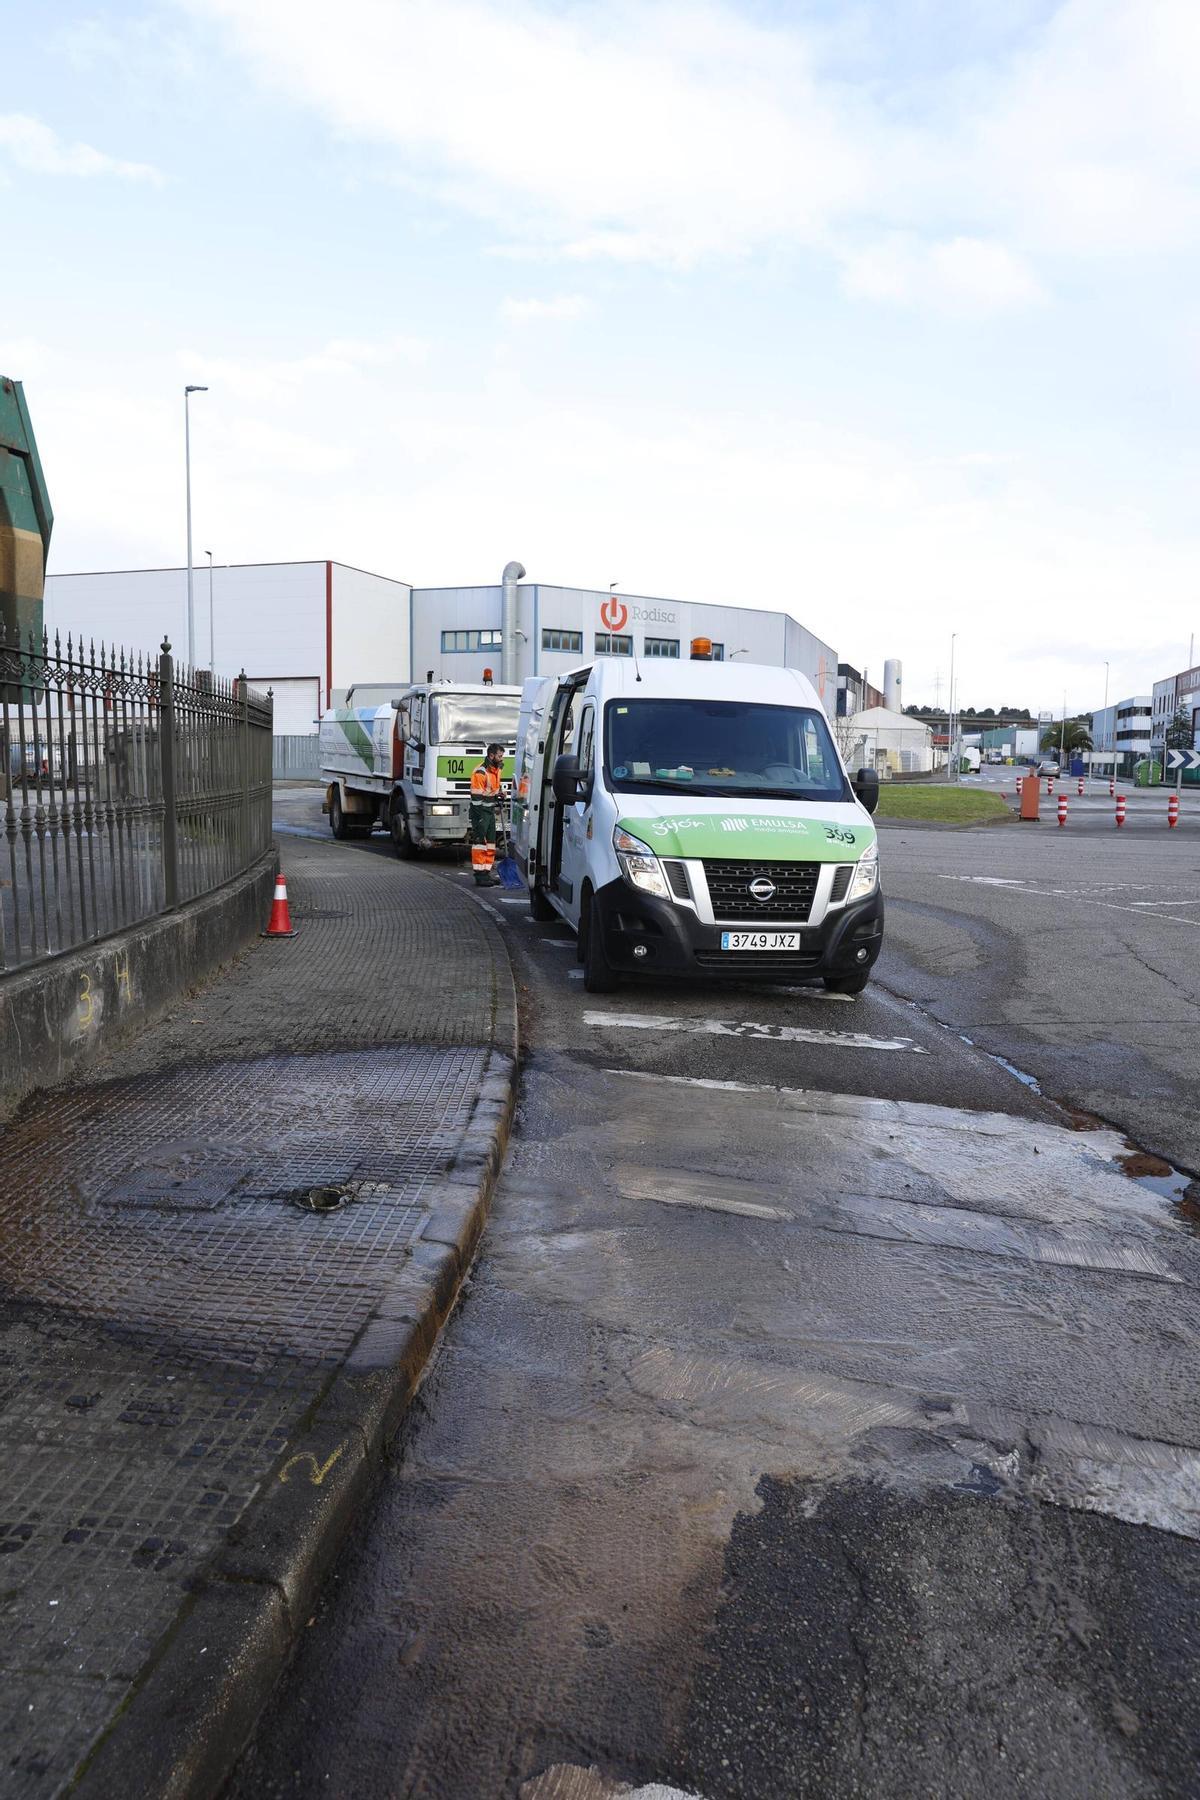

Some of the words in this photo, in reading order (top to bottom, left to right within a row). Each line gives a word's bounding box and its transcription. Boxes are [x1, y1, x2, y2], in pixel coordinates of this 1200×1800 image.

[632, 606, 676, 623] Rodisa
[447, 759, 465, 774] 104
[751, 818, 807, 830] EMULSA
[823, 827, 856, 845] 399
[732, 934, 768, 948] 3749
[770, 934, 796, 948] JXZ
